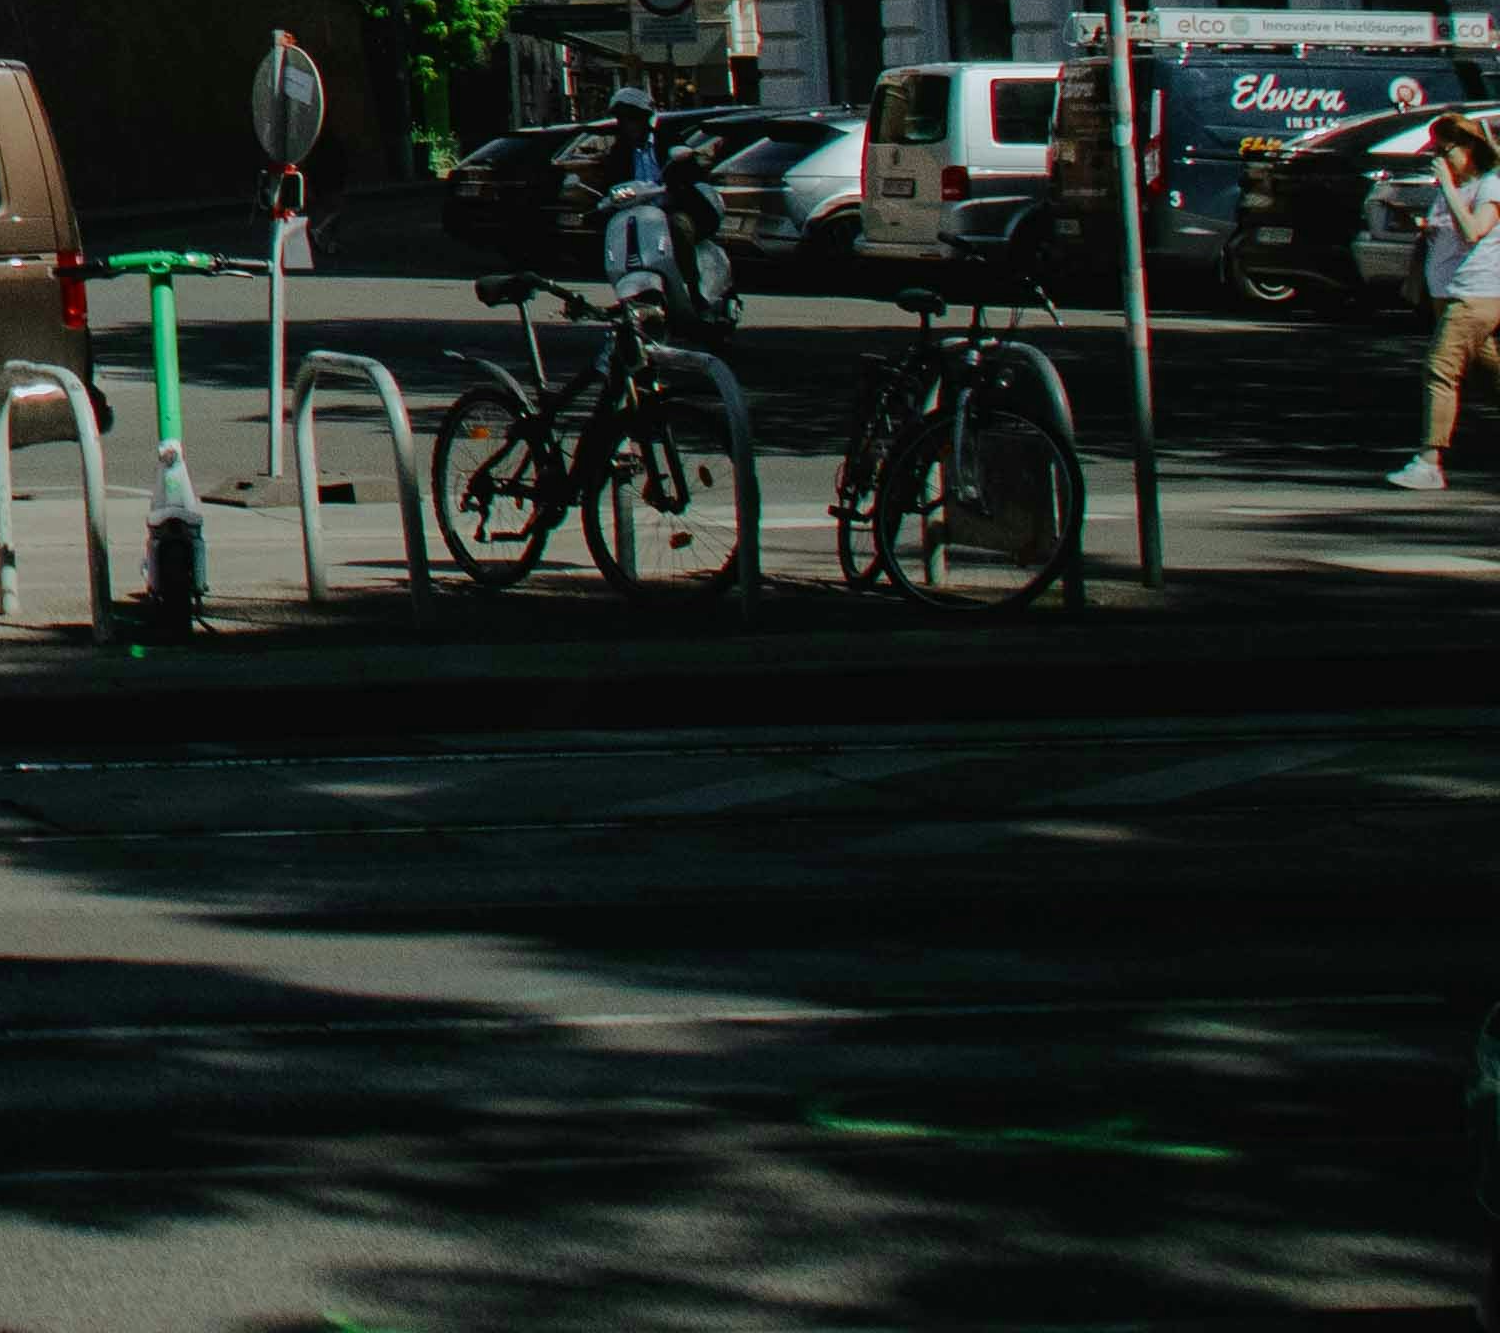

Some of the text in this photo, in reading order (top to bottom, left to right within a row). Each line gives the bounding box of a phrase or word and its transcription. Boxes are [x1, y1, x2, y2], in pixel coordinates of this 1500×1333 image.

[1177, 15, 1426, 37] elco Innovative Heizlösungen
[1232, 74, 1346, 111] Elwera
